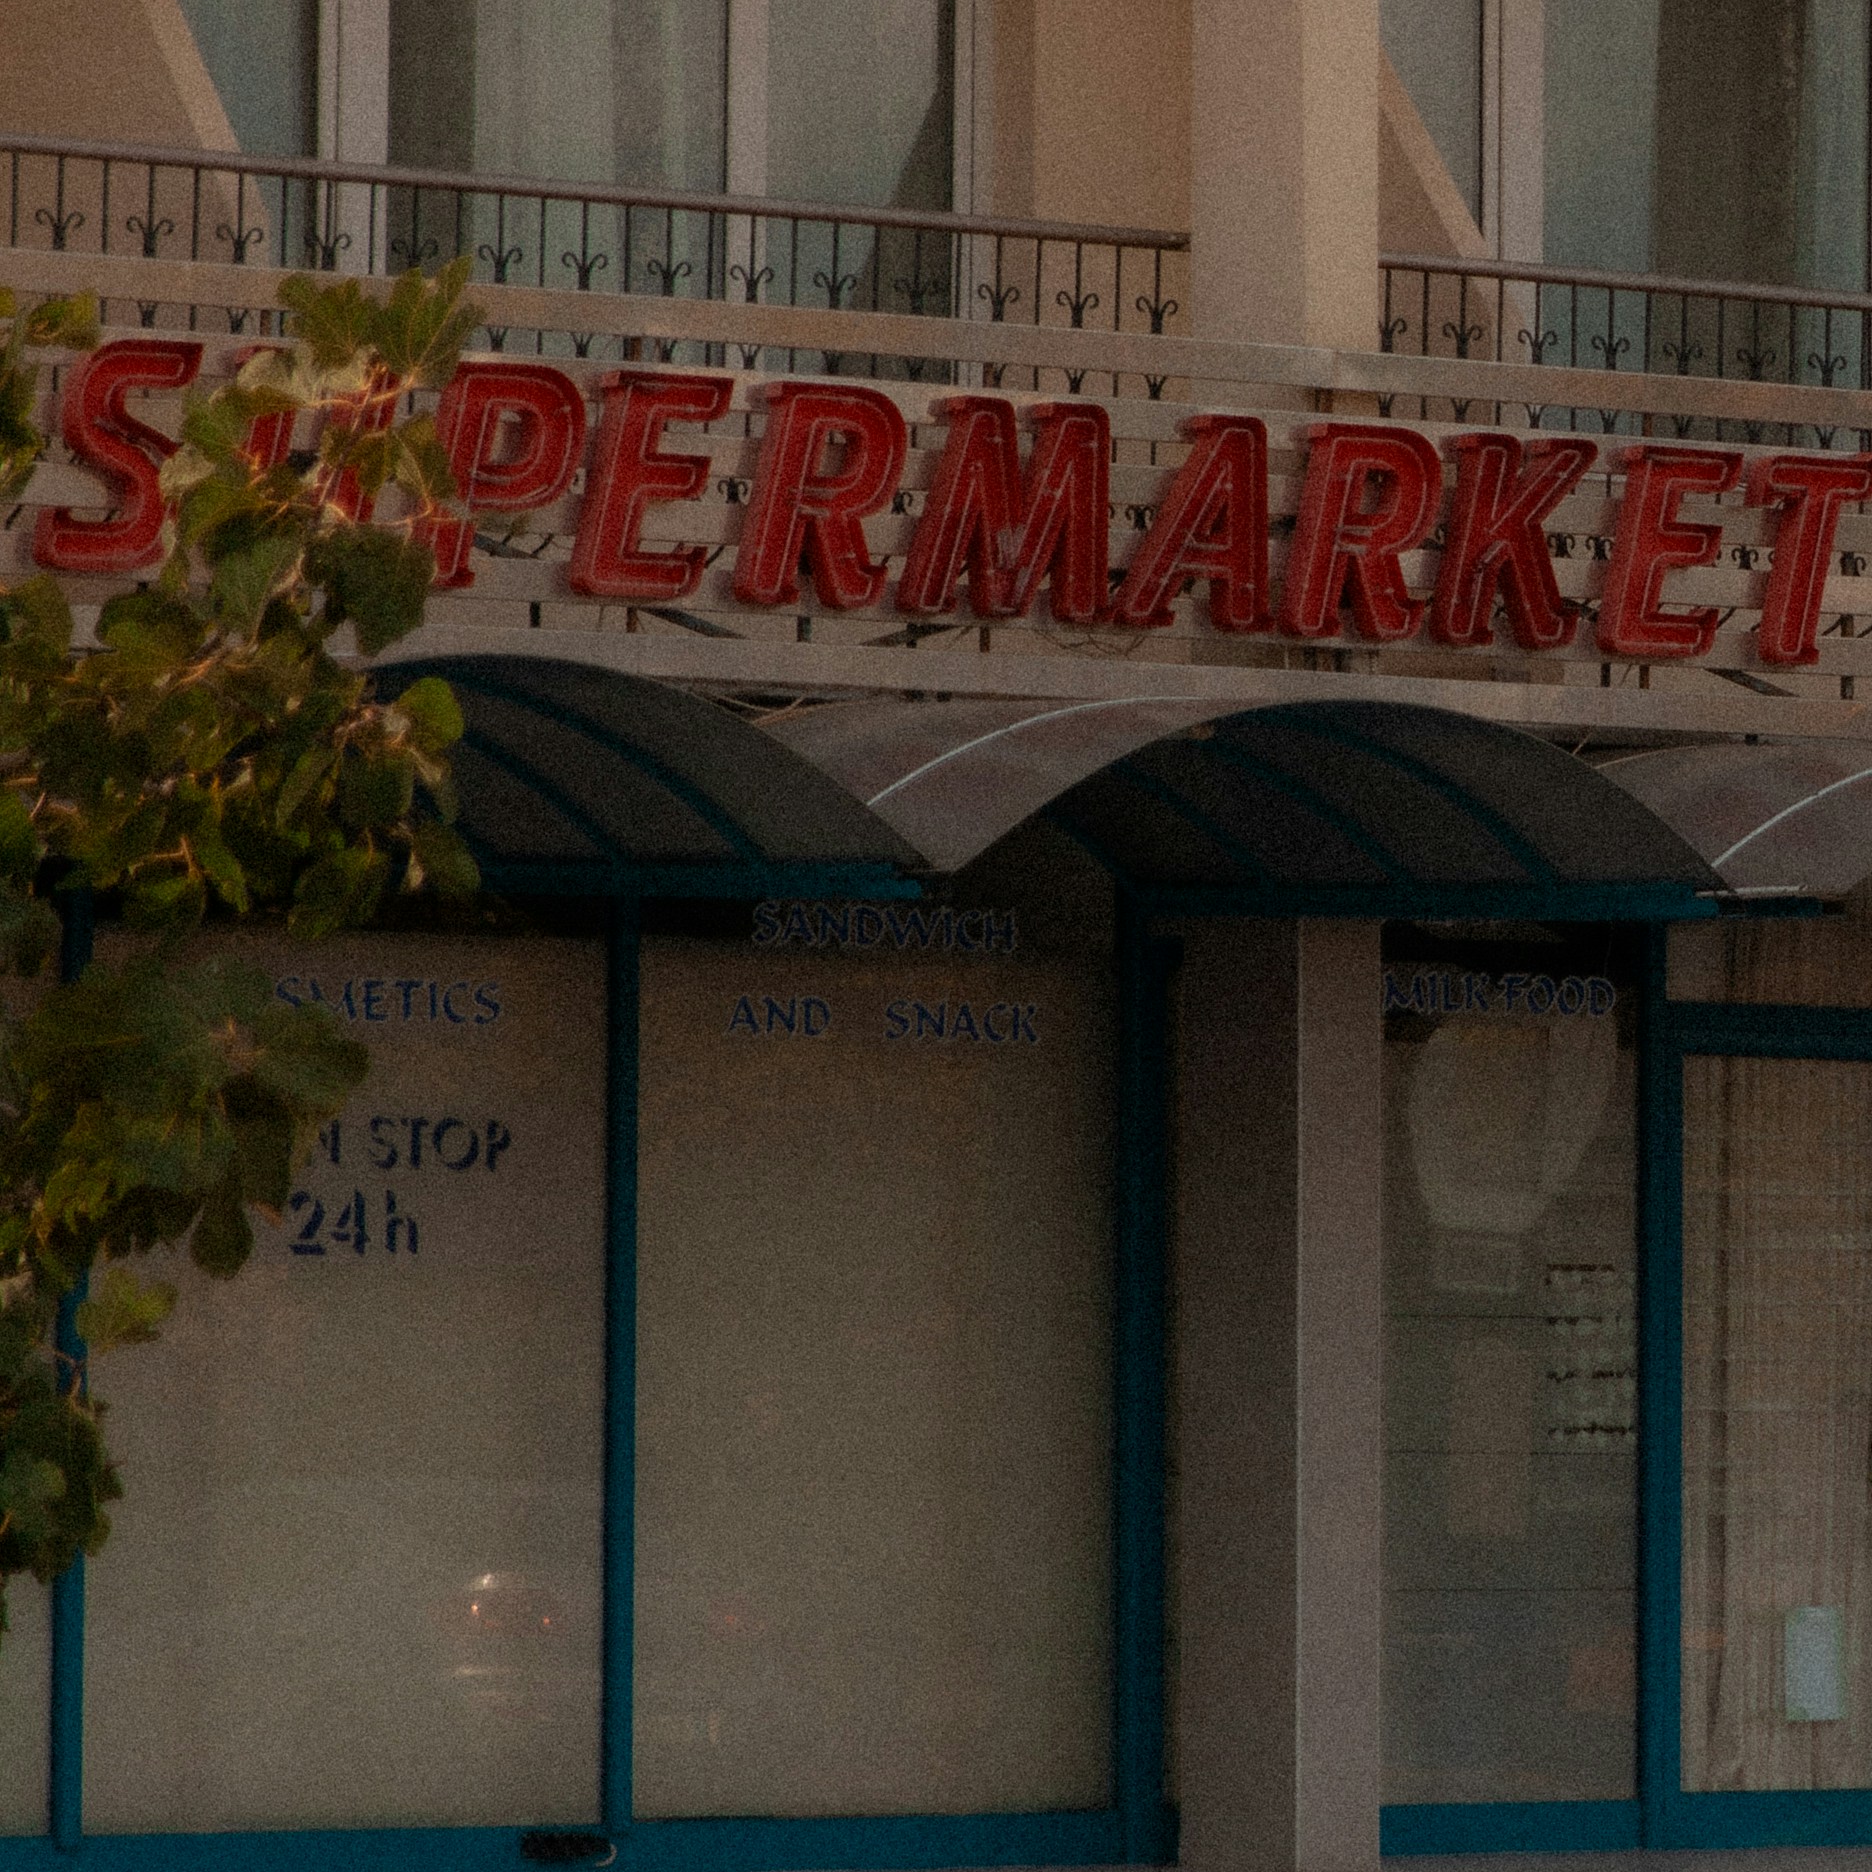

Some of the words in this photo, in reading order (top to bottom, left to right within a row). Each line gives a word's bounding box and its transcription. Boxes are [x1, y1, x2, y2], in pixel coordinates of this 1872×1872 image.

[752, 900, 1017, 953] SANDWICH
[275, 976, 502, 1025] SMETICS
[1383, 971, 1491, 1014] MILK
[1498, 973, 1616, 1016] FOOD
[727, 994, 832, 1038] AND
[884, 999, 1040, 1045] SNACK
[368, 1114, 512, 1172] STOP
